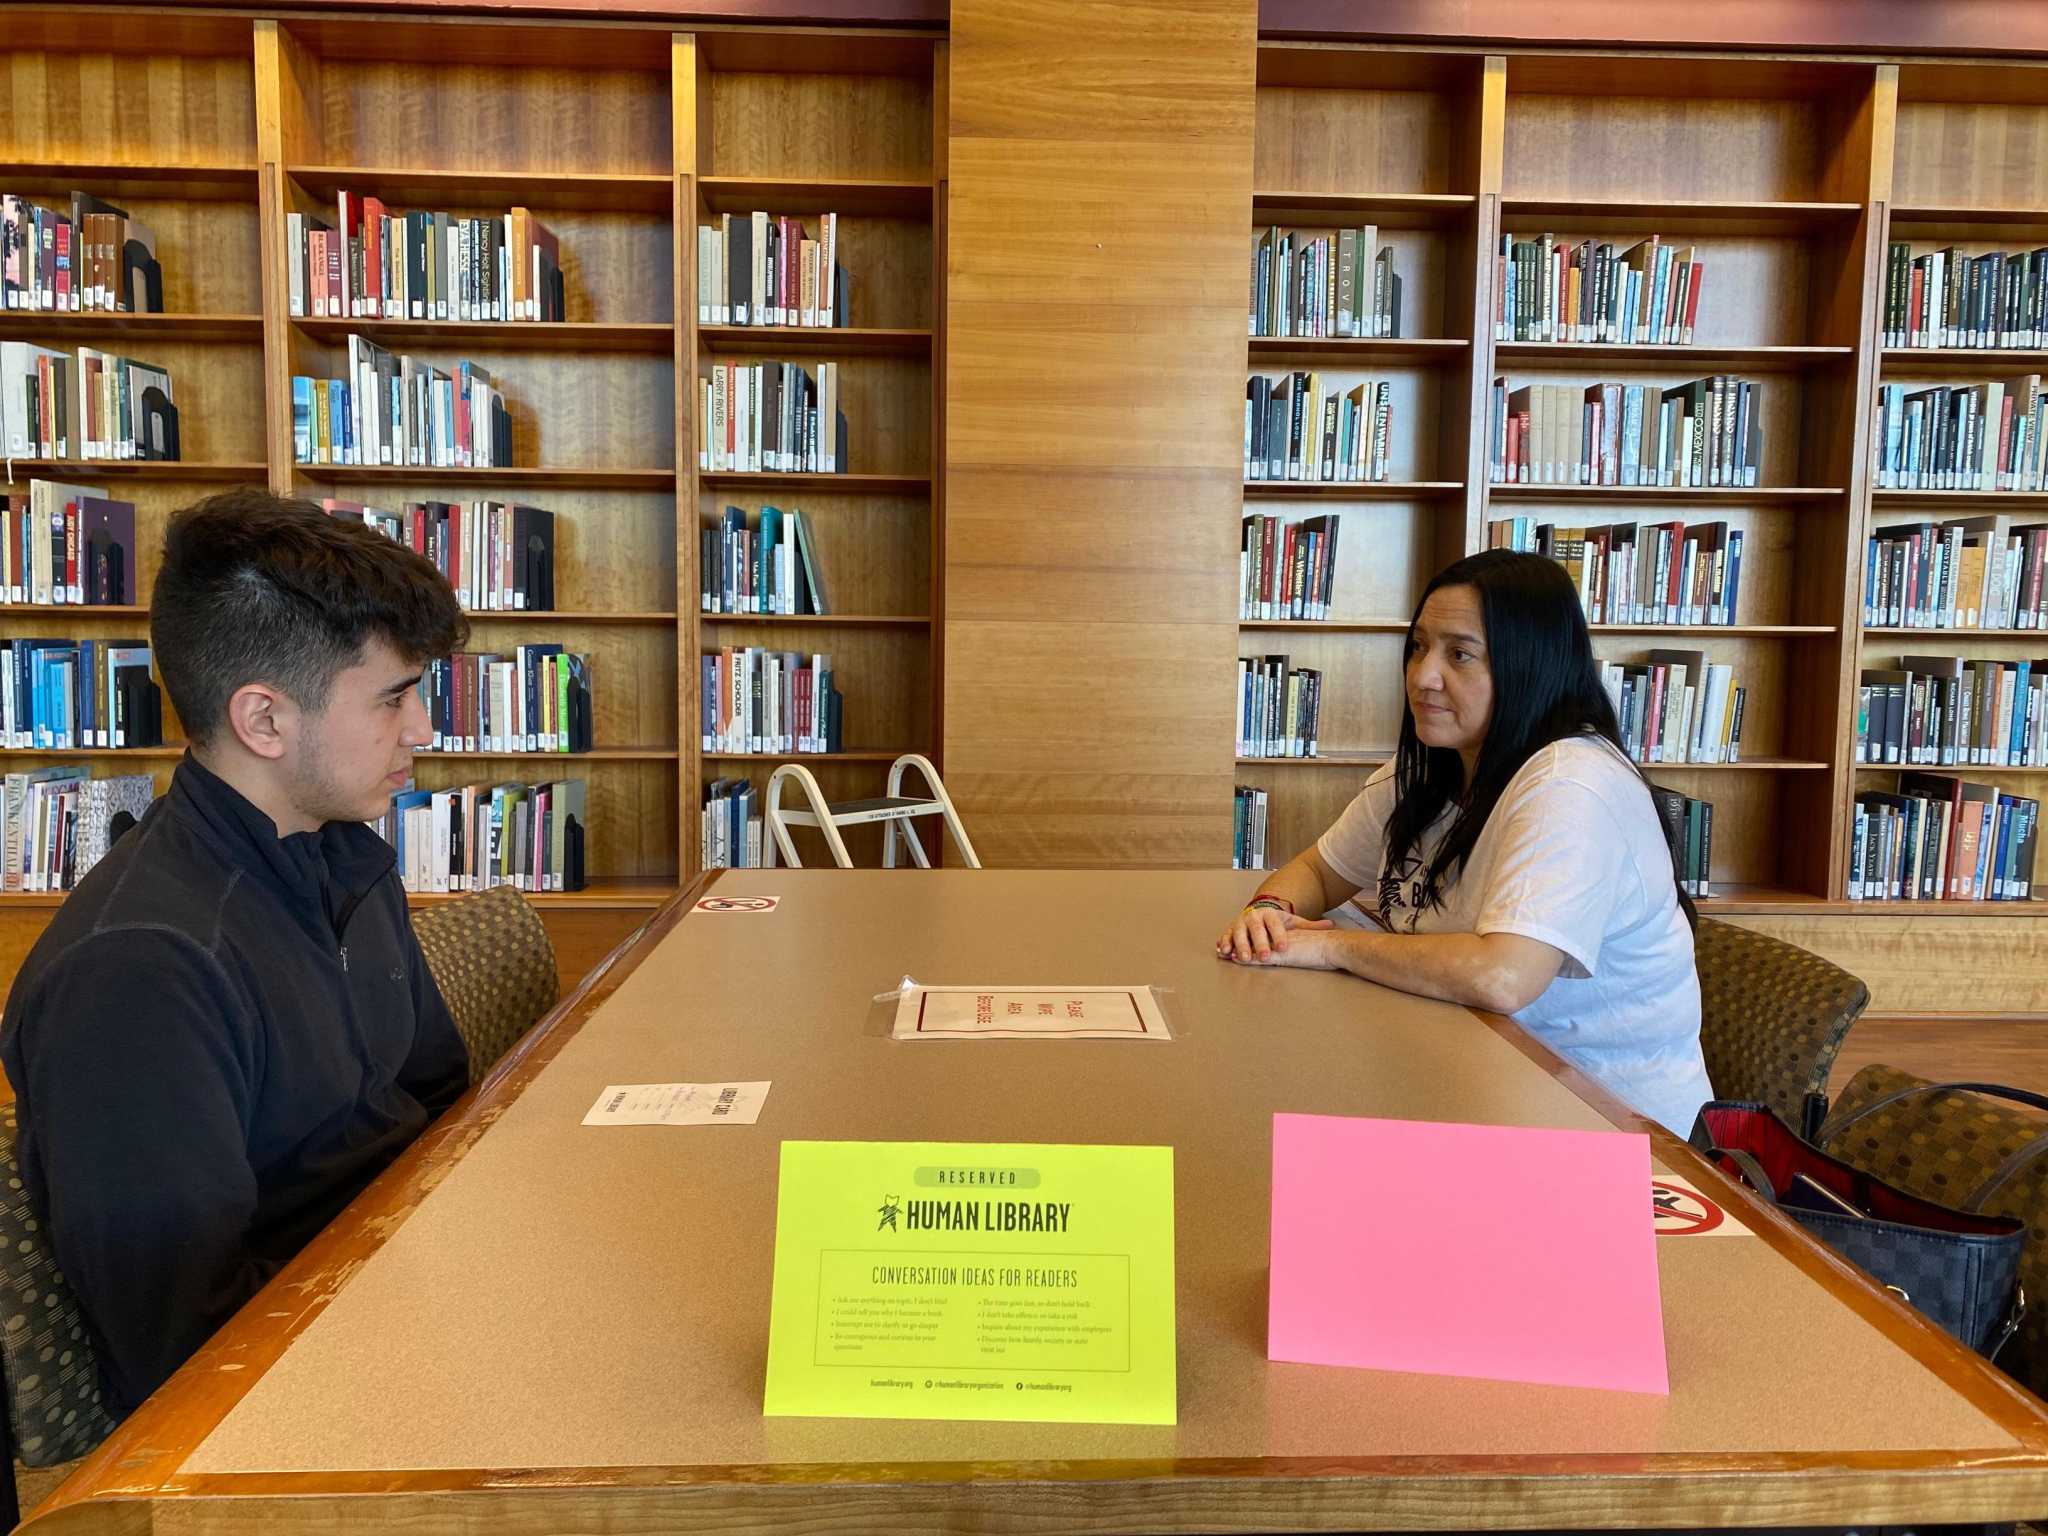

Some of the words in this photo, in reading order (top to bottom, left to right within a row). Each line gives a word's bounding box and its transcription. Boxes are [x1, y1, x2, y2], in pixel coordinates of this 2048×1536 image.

[460, 222, 469, 240] EVA
[481, 225, 490, 251] Nancy
[459, 244, 469, 273] HESSE
[481, 271, 490, 302] Sightlin
[715, 369, 724, 396] LARRY
[715, 398, 724, 426] RIVERS
[2030, 385, 2039, 416] PRIVATE
[1694, 418, 1704, 455] MEXICO
[2027, 420, 2035, 441] VIEW
[1941, 538, 1951, 585] CONSTABLE
[1294, 560, 1305, 595] Whistler
[6, 777, 21, 889] FRANKENTHALER
[1869, 833, 1878, 852] JACK
[2017, 815, 2028, 844] Mucha
[1868, 854, 1876, 877] YEATS
[939, 1170, 1016, 1185] RESERVED
[907, 1200, 979, 1231] HUMAN
[985, 1201, 1070, 1232] LIBRARY
[872, 1266, 957, 1285] CONVERSATION
[962, 1268, 994, 1287] IDEAS
[1000, 1268, 1021, 1287] FOR
[1026, 1269, 1077, 1288] READERS
